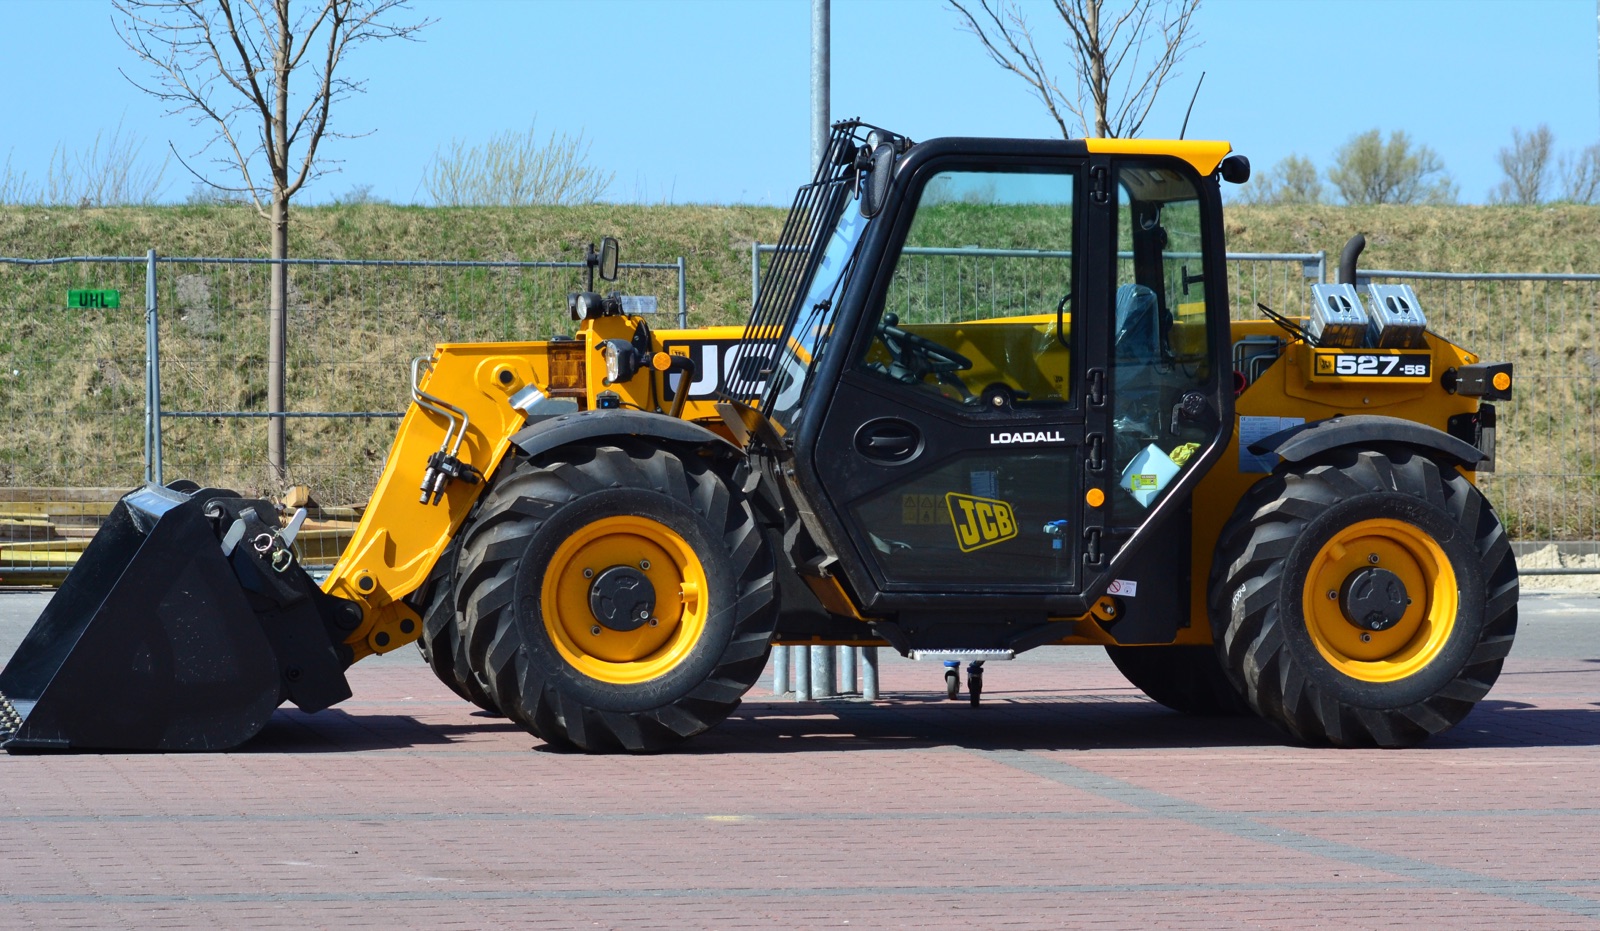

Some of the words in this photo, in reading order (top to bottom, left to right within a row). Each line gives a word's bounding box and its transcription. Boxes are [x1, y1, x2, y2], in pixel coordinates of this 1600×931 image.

[79, 292, 109, 308] UHL
[669, 344, 777, 396] JC
[990, 431, 1065, 444] LOADALL
[957, 498, 1014, 547] JCB
